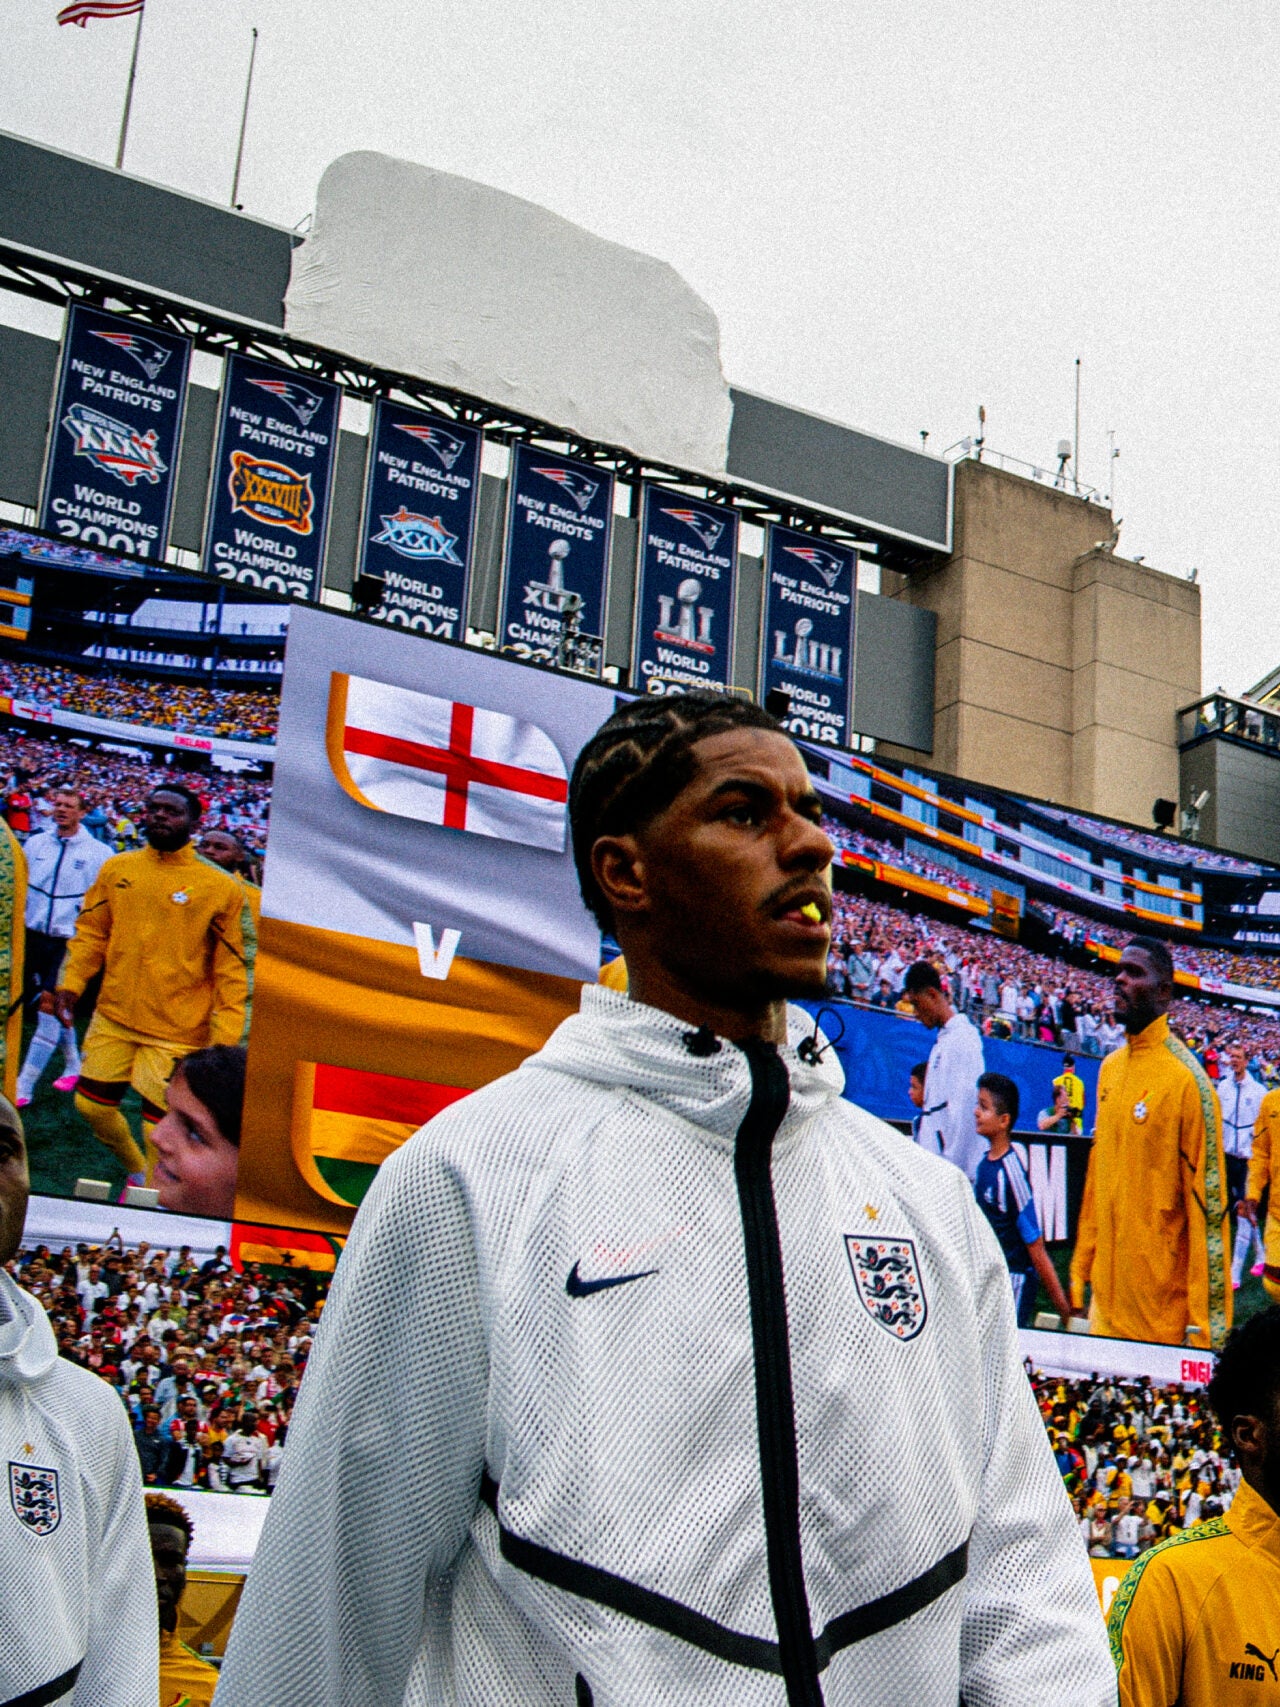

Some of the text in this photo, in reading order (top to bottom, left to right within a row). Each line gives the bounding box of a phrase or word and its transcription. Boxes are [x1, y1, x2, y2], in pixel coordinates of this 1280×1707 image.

[71, 359, 176, 400] NEW ENGLAND
[81, 377, 162, 412] PATRIOTS
[230, 406, 328, 446] NEW ENGLAND
[240, 424, 315, 458] PATRIOTS
[378, 451, 470, 489] NEW ENGLAND
[387, 468, 459, 500] PATRIOTS
[74, 484, 141, 516] WORLD
[517, 494, 604, 529] NEW ENGLAND
[52, 499, 158, 539] CHAMPIONS
[526, 510, 594, 541] PATRIOTS
[234, 528, 297, 559] WORLD
[648, 534, 731, 568] NEW ENGLAND
[214, 542, 313, 582] CHAMPIONS
[657, 550, 721, 580] PATRIOTS
[384, 570, 443, 599] WORLD
[772, 572, 850, 604] NEW ENGLAND
[382, 592, 459, 621] HAMPIONS
[780, 588, 840, 616] PATRIOTS
[641, 660, 724, 693] CHAMPIONS
[657, 647, 710, 674] WORLD
[781, 682, 831, 707] WORLD
[788, 702, 844, 727] AMPIONS
[778, 718, 840, 745] 018
[412, 921, 462, 981] V
[1181, 1359, 1212, 1384] ENGL
[1229, 1661, 1265, 1682] KING
